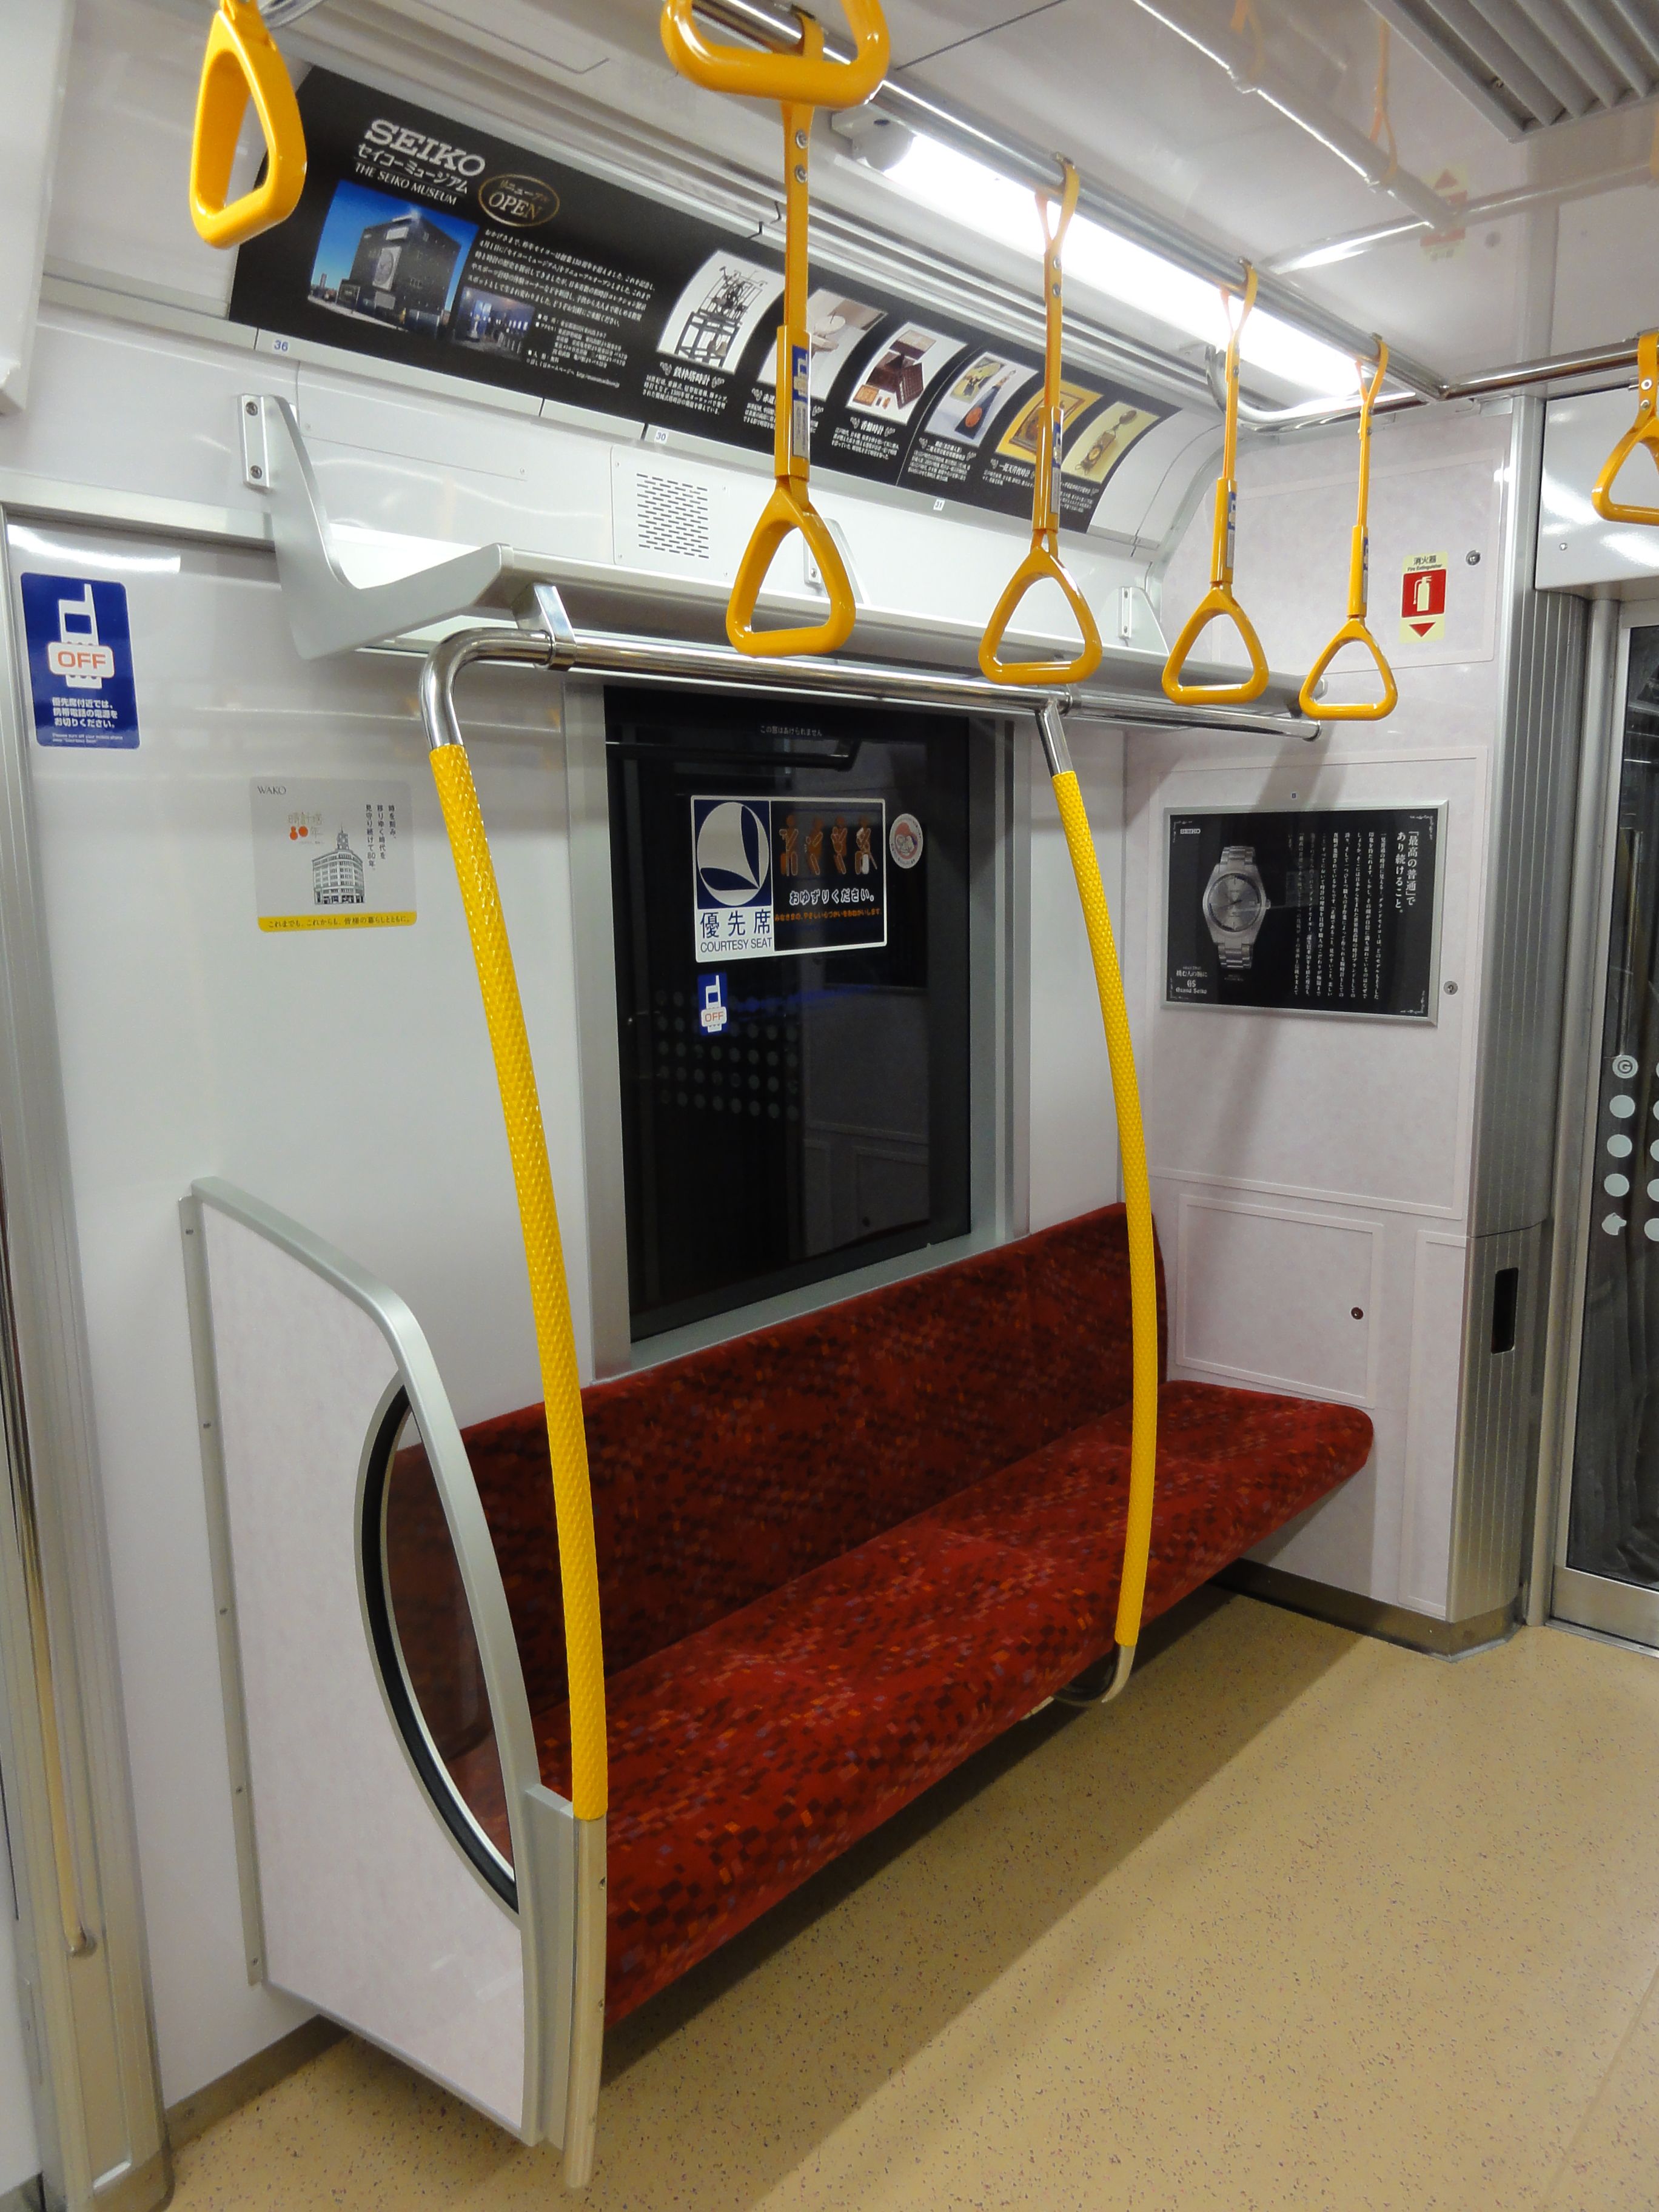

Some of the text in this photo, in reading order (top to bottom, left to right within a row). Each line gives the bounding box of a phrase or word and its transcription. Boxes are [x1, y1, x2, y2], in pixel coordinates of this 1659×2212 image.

[364, 119, 485, 176] SEIKO
[358, 143, 468, 194] セイコーミュージアム
[355, 162, 457, 205] THE SEIKO MUSEUM
[489, 192, 542, 220] OPEN
[274, 340, 288, 352] 36
[656, 431, 666, 441] 30
[1413, 555, 1437, 565] 消火器
[58, 651, 106, 669] OFF
[52, 697, 113, 709] 優先席付近では、
[53, 707, 118, 719] 携帯電話の電源を
[55, 717, 115, 728] お切りください。
[257, 786, 286, 795] WAKO
[1395, 832, 1406, 913] あり続けること。
[1406, 831, 1419, 906] 「最高の普通」で
[789, 888, 875, 906] おゆずりください。
[700, 909, 771, 939] 優先席
[700, 937, 773, 953] COURTESY SEAT
[705, 1011, 724, 1022] OFF
